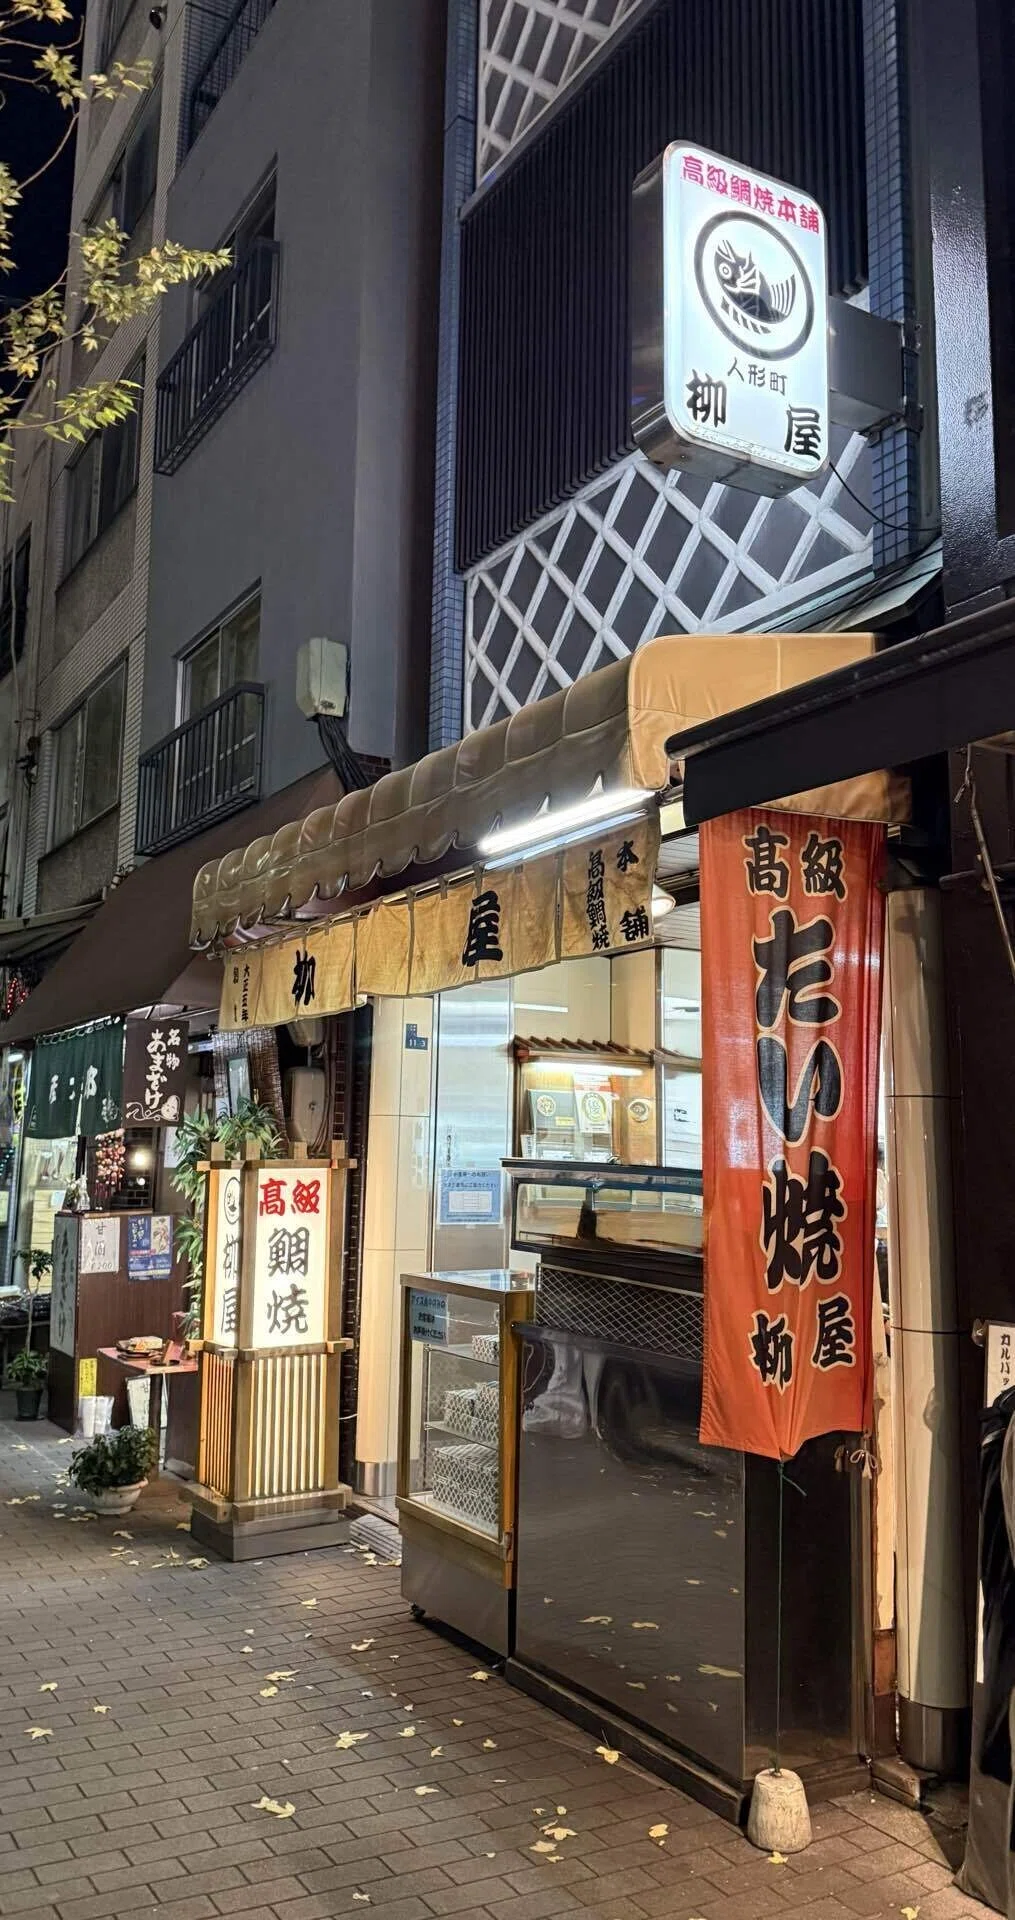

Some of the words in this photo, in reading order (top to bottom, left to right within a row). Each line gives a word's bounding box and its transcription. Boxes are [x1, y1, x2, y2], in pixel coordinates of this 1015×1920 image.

[727, 357, 788, 396] 人形町
[144, 1028, 168, 1110] あまざけ
[752, 908, 844, 1293] たい焼
[267, 1226, 310, 1335] 鯛焼
